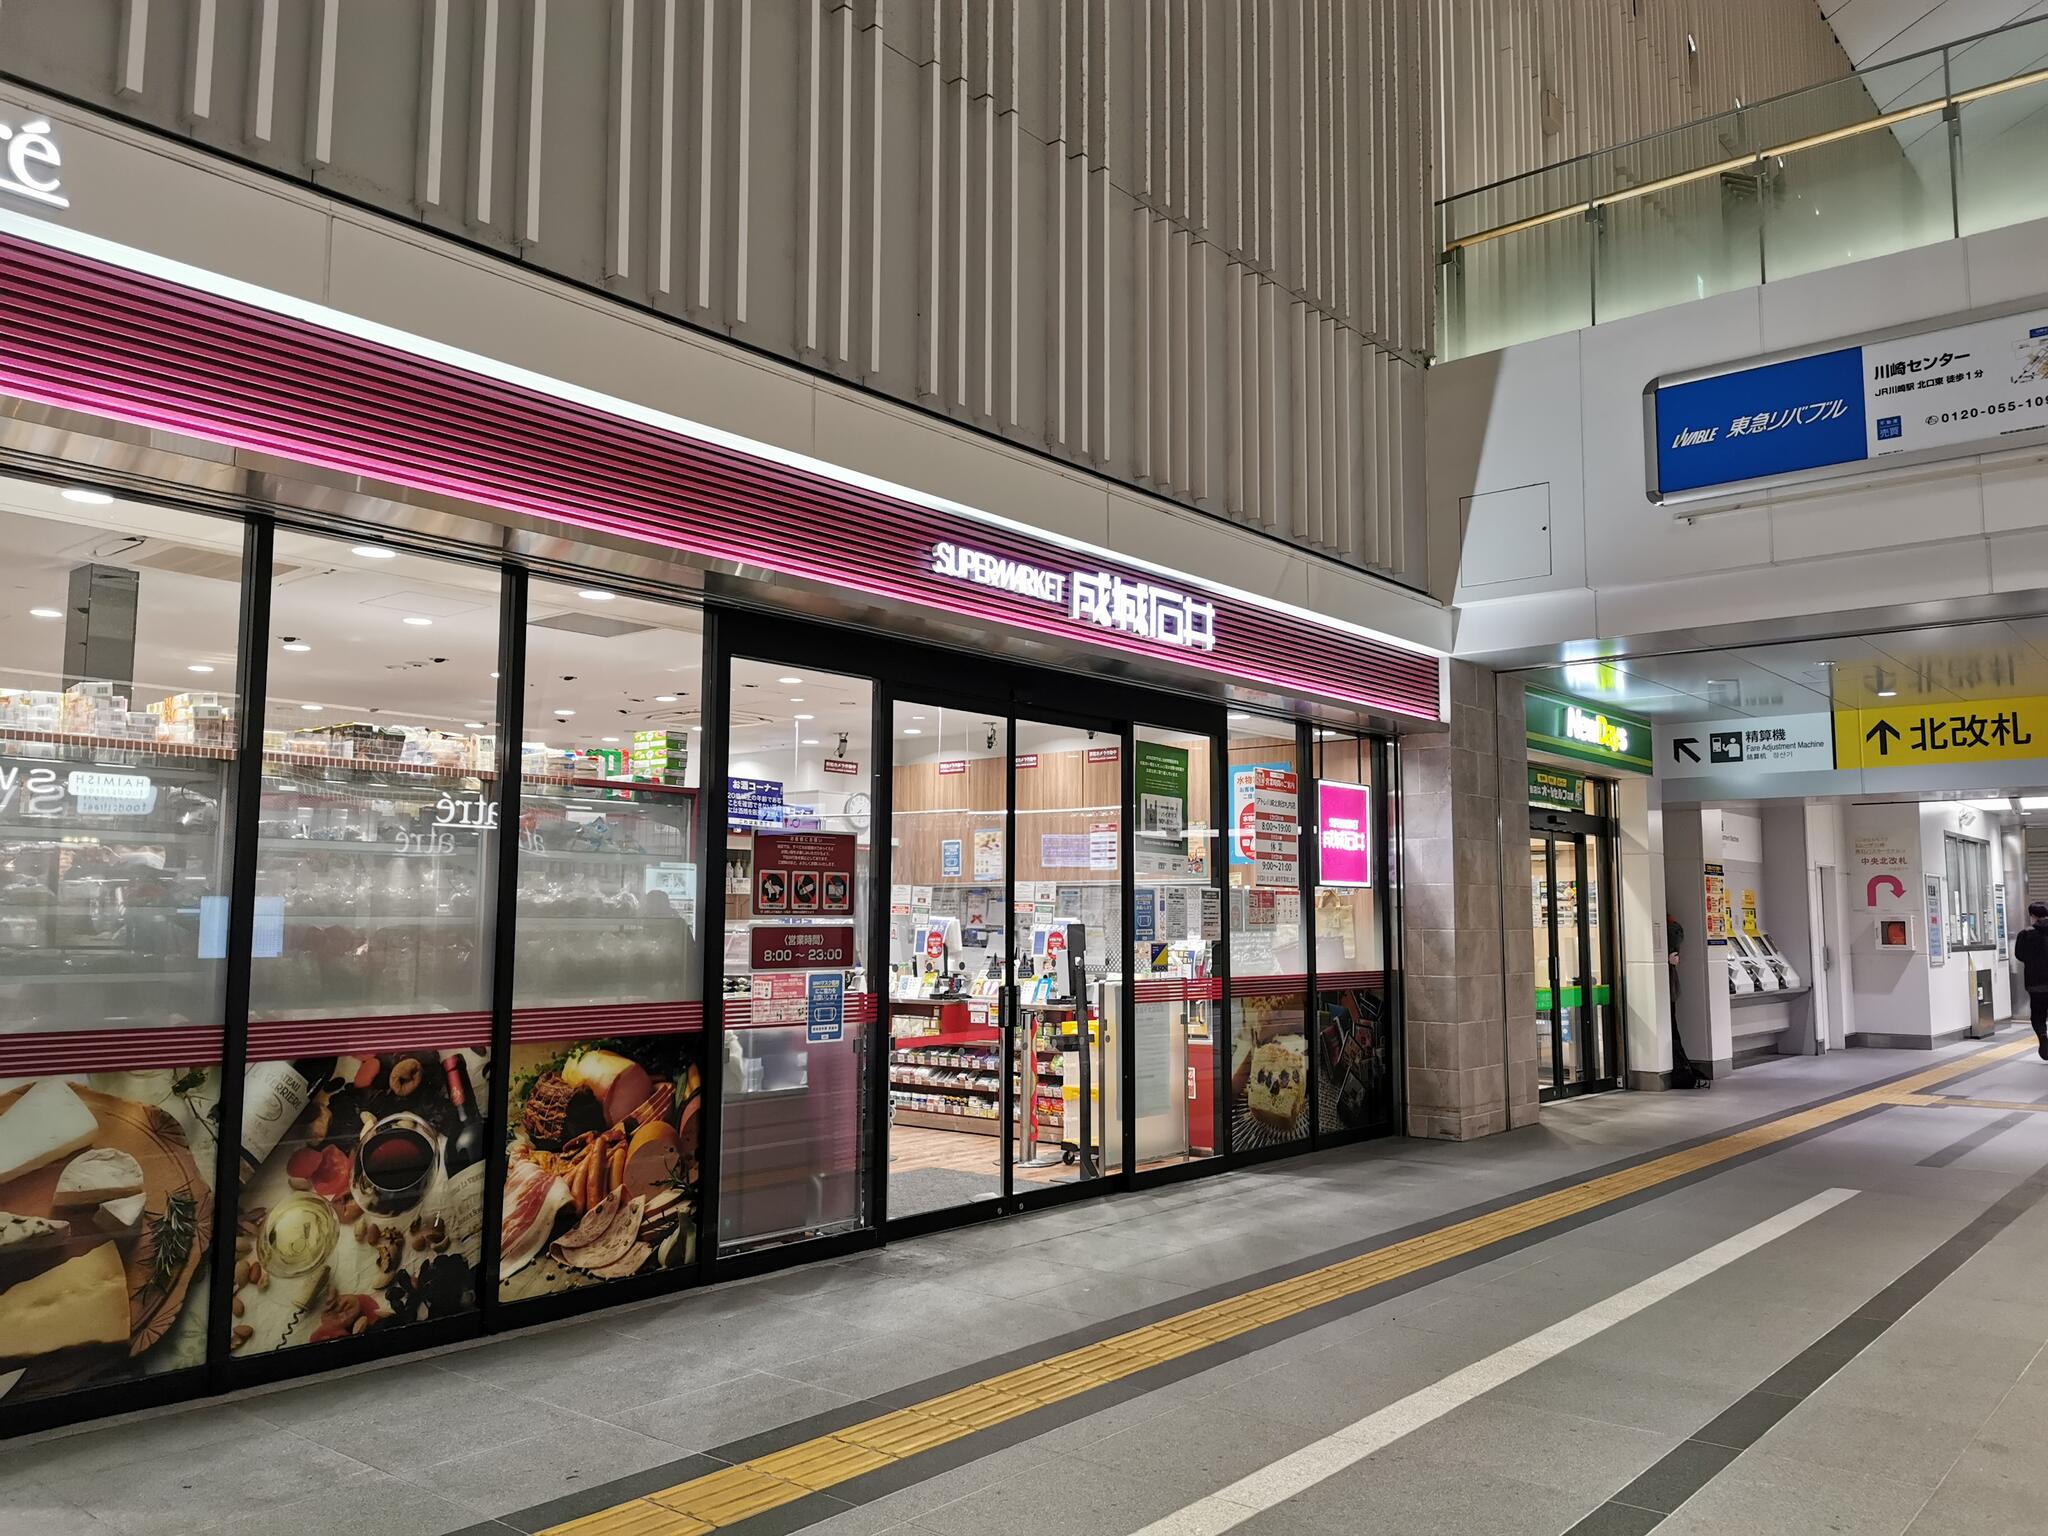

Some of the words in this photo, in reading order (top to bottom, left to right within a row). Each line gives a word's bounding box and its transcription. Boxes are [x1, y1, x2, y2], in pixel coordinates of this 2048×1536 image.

[1874, 352, 1971, 380] 川崎センター
[1874, 382, 1915, 397] JR川崎駅
[1917, 376, 1944, 390] 北口東
[1726, 398, 1848, 439] 東急リバブル
[1879, 427, 1900, 438] 売買
[932, 541, 1065, 604] SUPERMARKET
[1069, 571, 1216, 651] 成城石井
[1566, 705, 1629, 752] NewDays
[1745, 728, 1786, 743] 精算機
[1910, 712, 2033, 751] 北改札
[1746, 744, 1761, 752] Fare
[1761, 742, 1797, 752] Adjustment
[1797, 740, 1825, 748] Machine
[732, 780, 779, 792] お酒コーナー
[1861, 856, 1908, 865] 中央北改札
[763, 949, 792, 961] 8:00
[808, 948, 842, 960] 23:00
